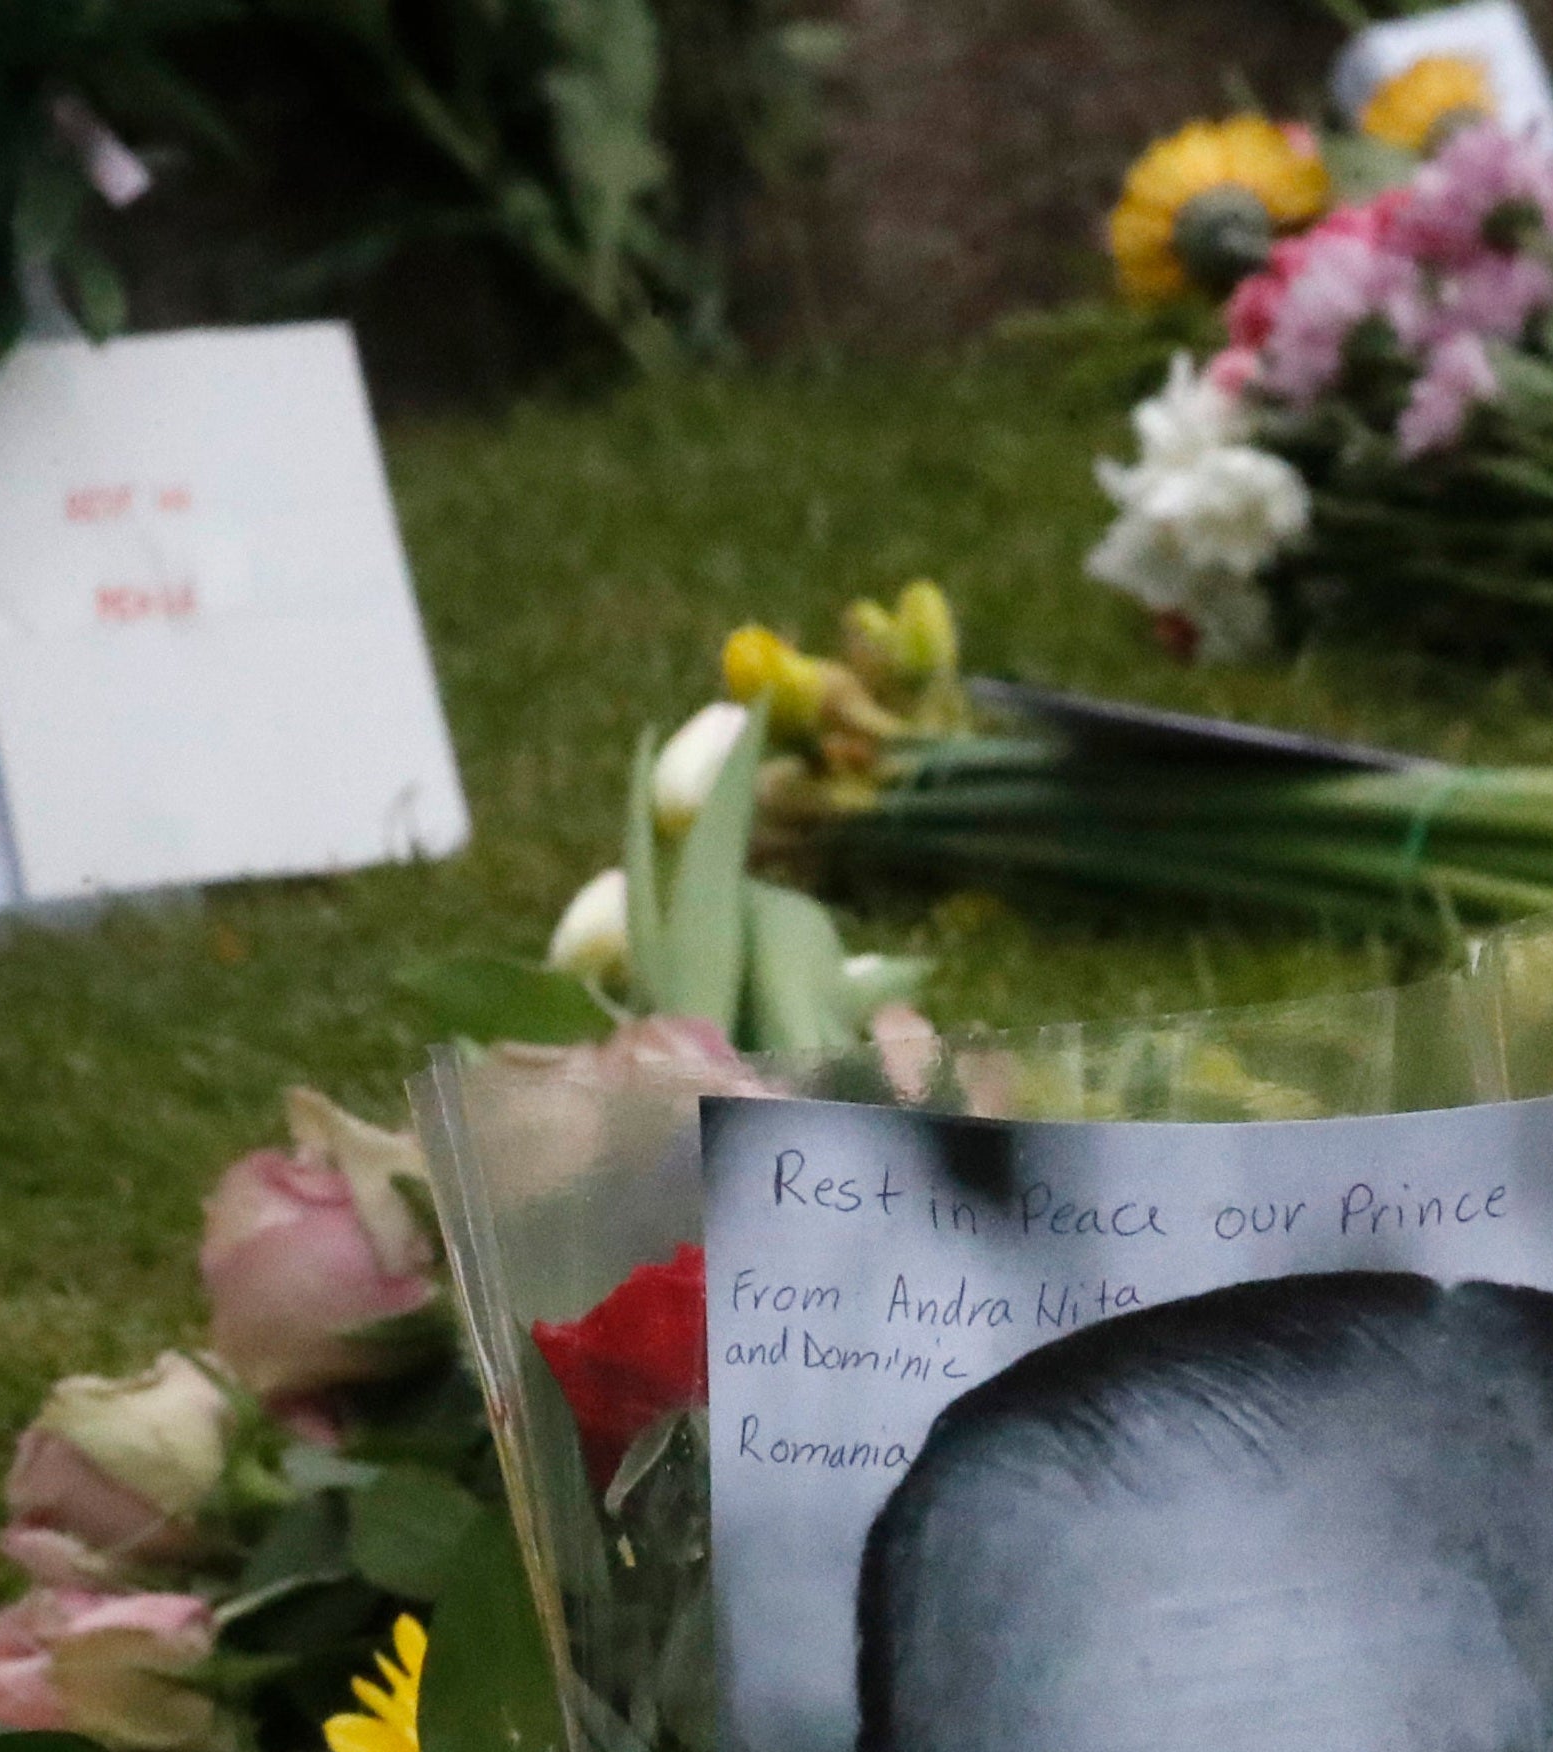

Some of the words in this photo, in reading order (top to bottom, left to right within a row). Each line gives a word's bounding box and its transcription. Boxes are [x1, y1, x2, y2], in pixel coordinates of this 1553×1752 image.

[773, 1149, 904, 1215] Rest
[928, 1182, 977, 1235] in
[1021, 1181, 1167, 1238] Peace
[1215, 1200, 1305, 1240] our
[1341, 1182, 1507, 1235] Prince
[732, 1269, 841, 1313] From
[887, 1274, 1013, 1328] Andra
[1036, 1279, 1144, 1327] Nita
[725, 1328, 788, 1366] and
[803, 1331, 968, 1381] Dominic
[738, 1414, 913, 1469] Romania
